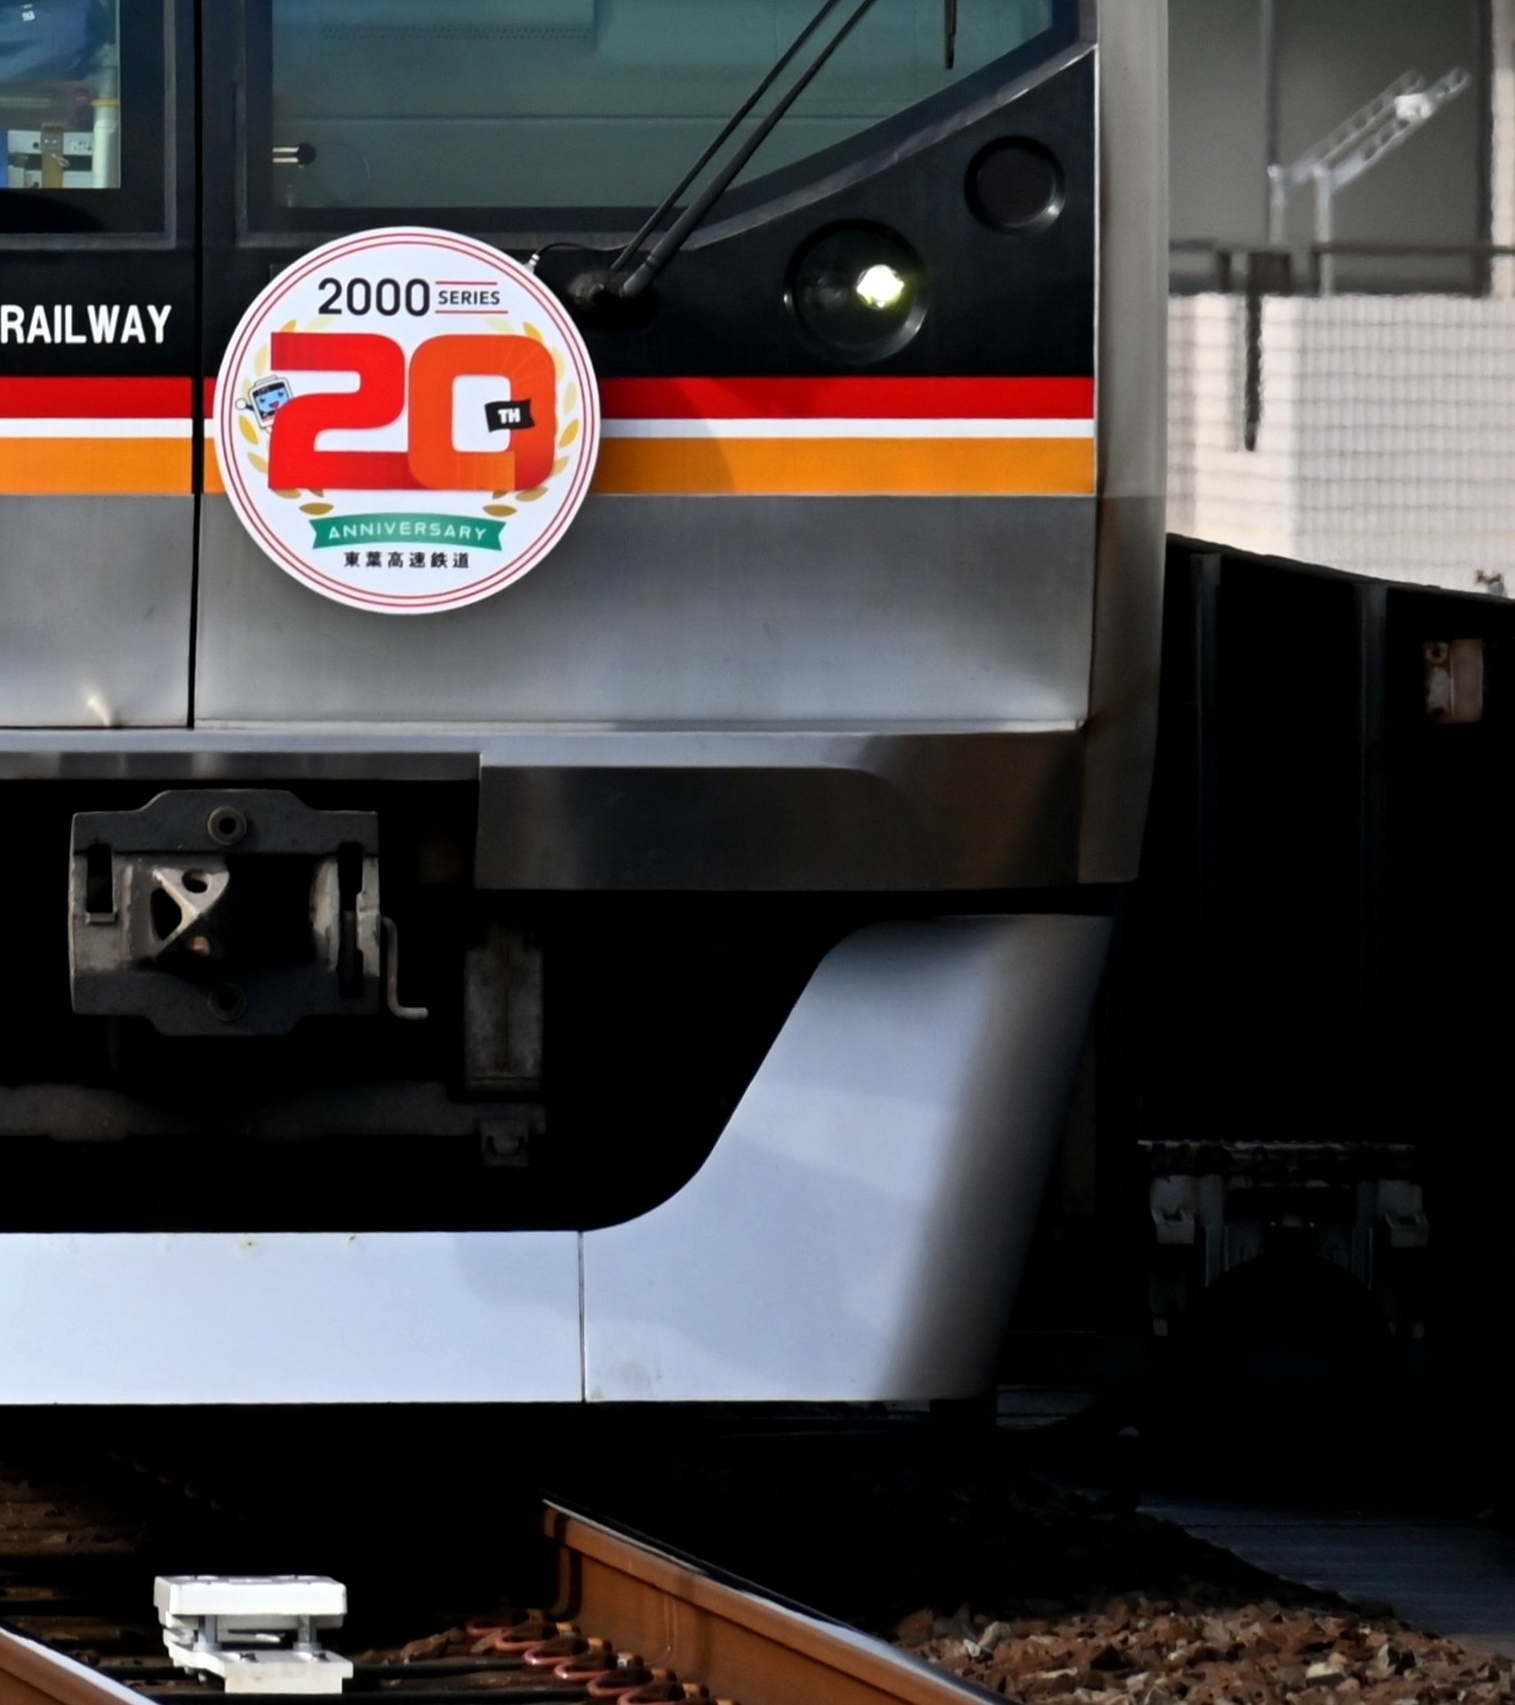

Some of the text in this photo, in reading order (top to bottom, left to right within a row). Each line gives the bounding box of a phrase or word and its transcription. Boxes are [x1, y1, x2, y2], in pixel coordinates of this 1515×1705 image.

[318, 277, 500, 317] 2000 SERIES
[0, 304, 172, 344] RAILWAY
[268, 331, 556, 491] 20 TH
[328, 521, 487, 541] ANNIVERSARY
[344, 551, 469, 569] 東葉高速鉄道
